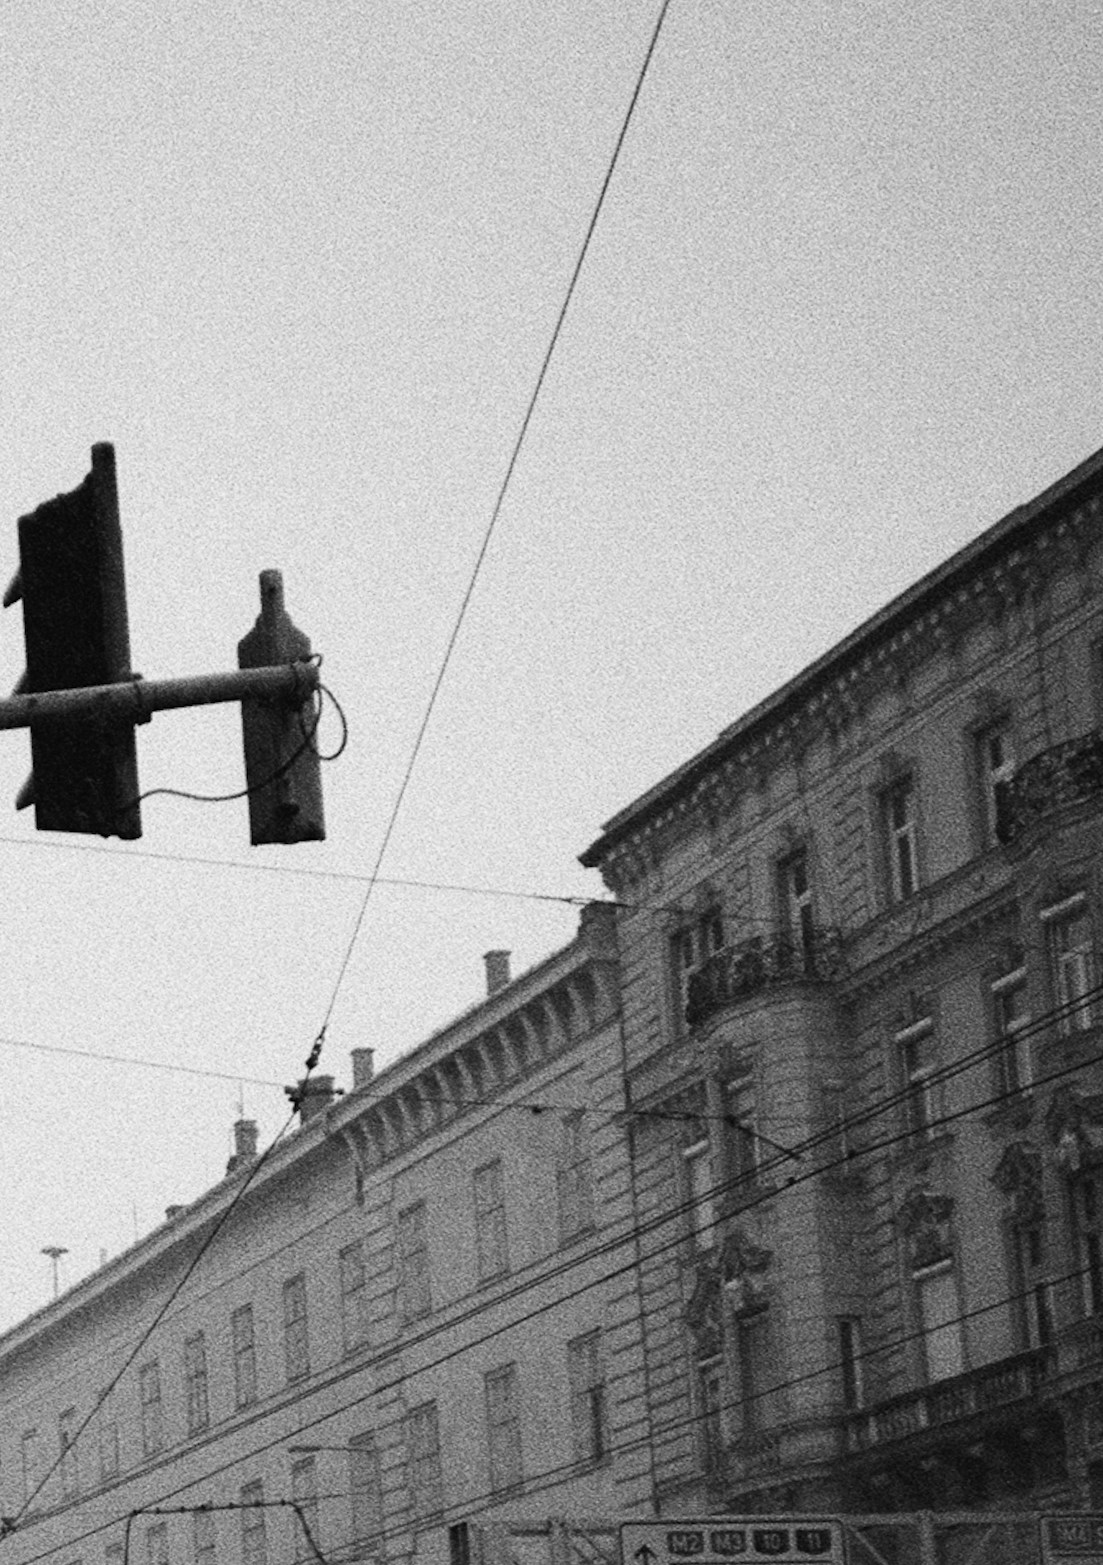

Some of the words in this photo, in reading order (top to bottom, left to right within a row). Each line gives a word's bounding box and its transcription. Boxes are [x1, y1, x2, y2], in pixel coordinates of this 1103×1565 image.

[672, 1534, 700, 1551] M2
[715, 1533, 742, 1550] M3
[762, 1533, 782, 1549] 10
[807, 1533, 821, 1549] 11
